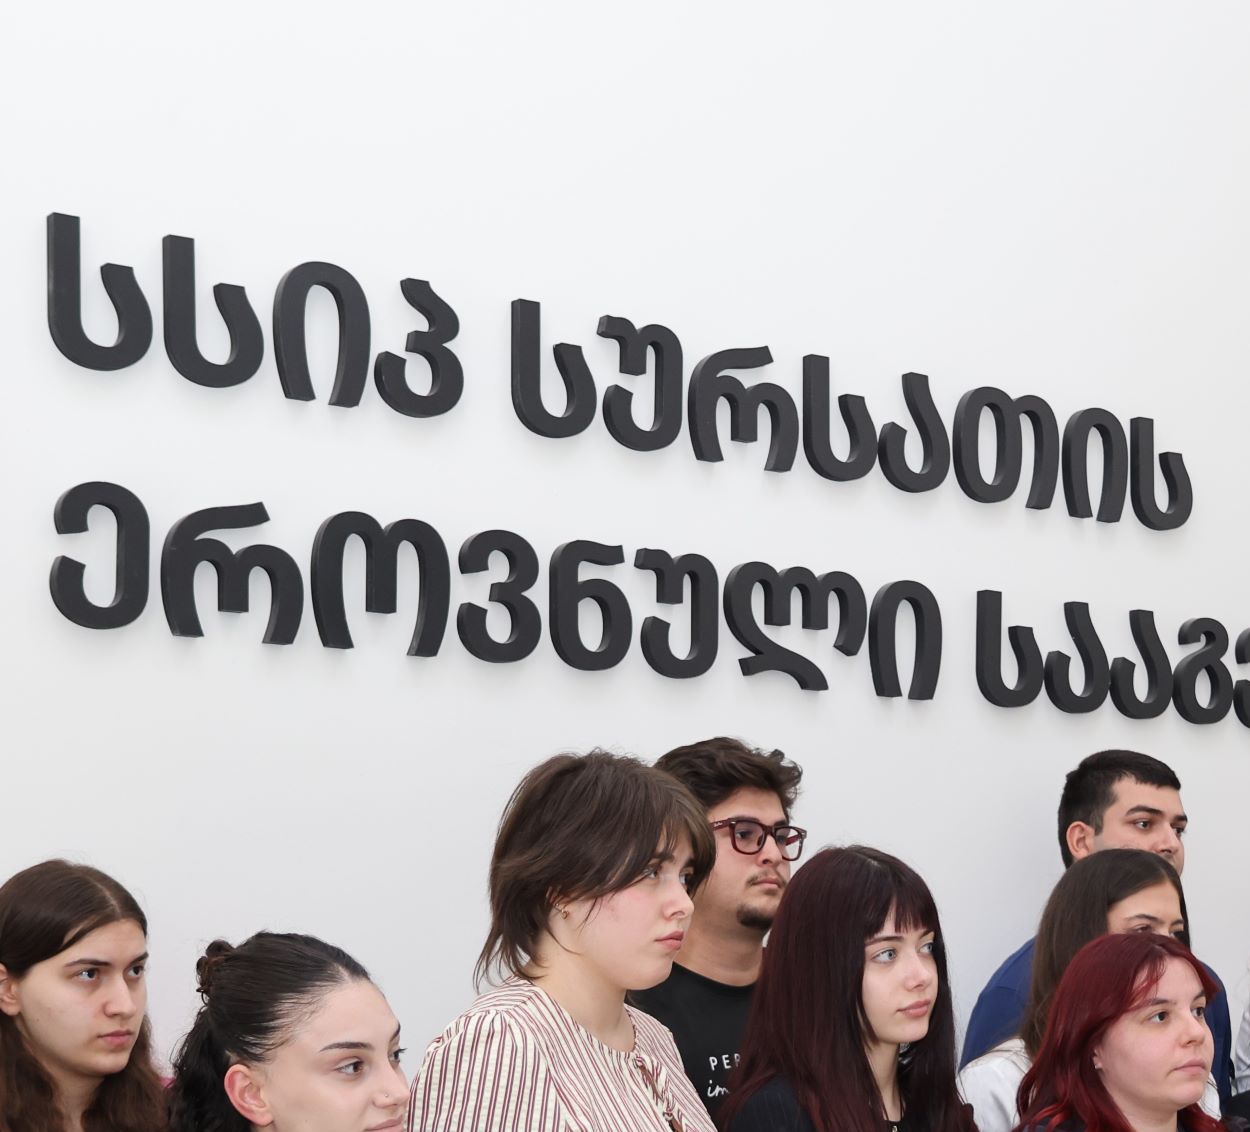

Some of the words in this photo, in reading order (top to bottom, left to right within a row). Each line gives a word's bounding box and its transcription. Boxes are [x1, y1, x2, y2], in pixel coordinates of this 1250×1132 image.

[47, 212, 463, 418] სსიპ
[511, 298, 1193, 531] სურსათის
[50, 481, 943, 700] ეროვნული
